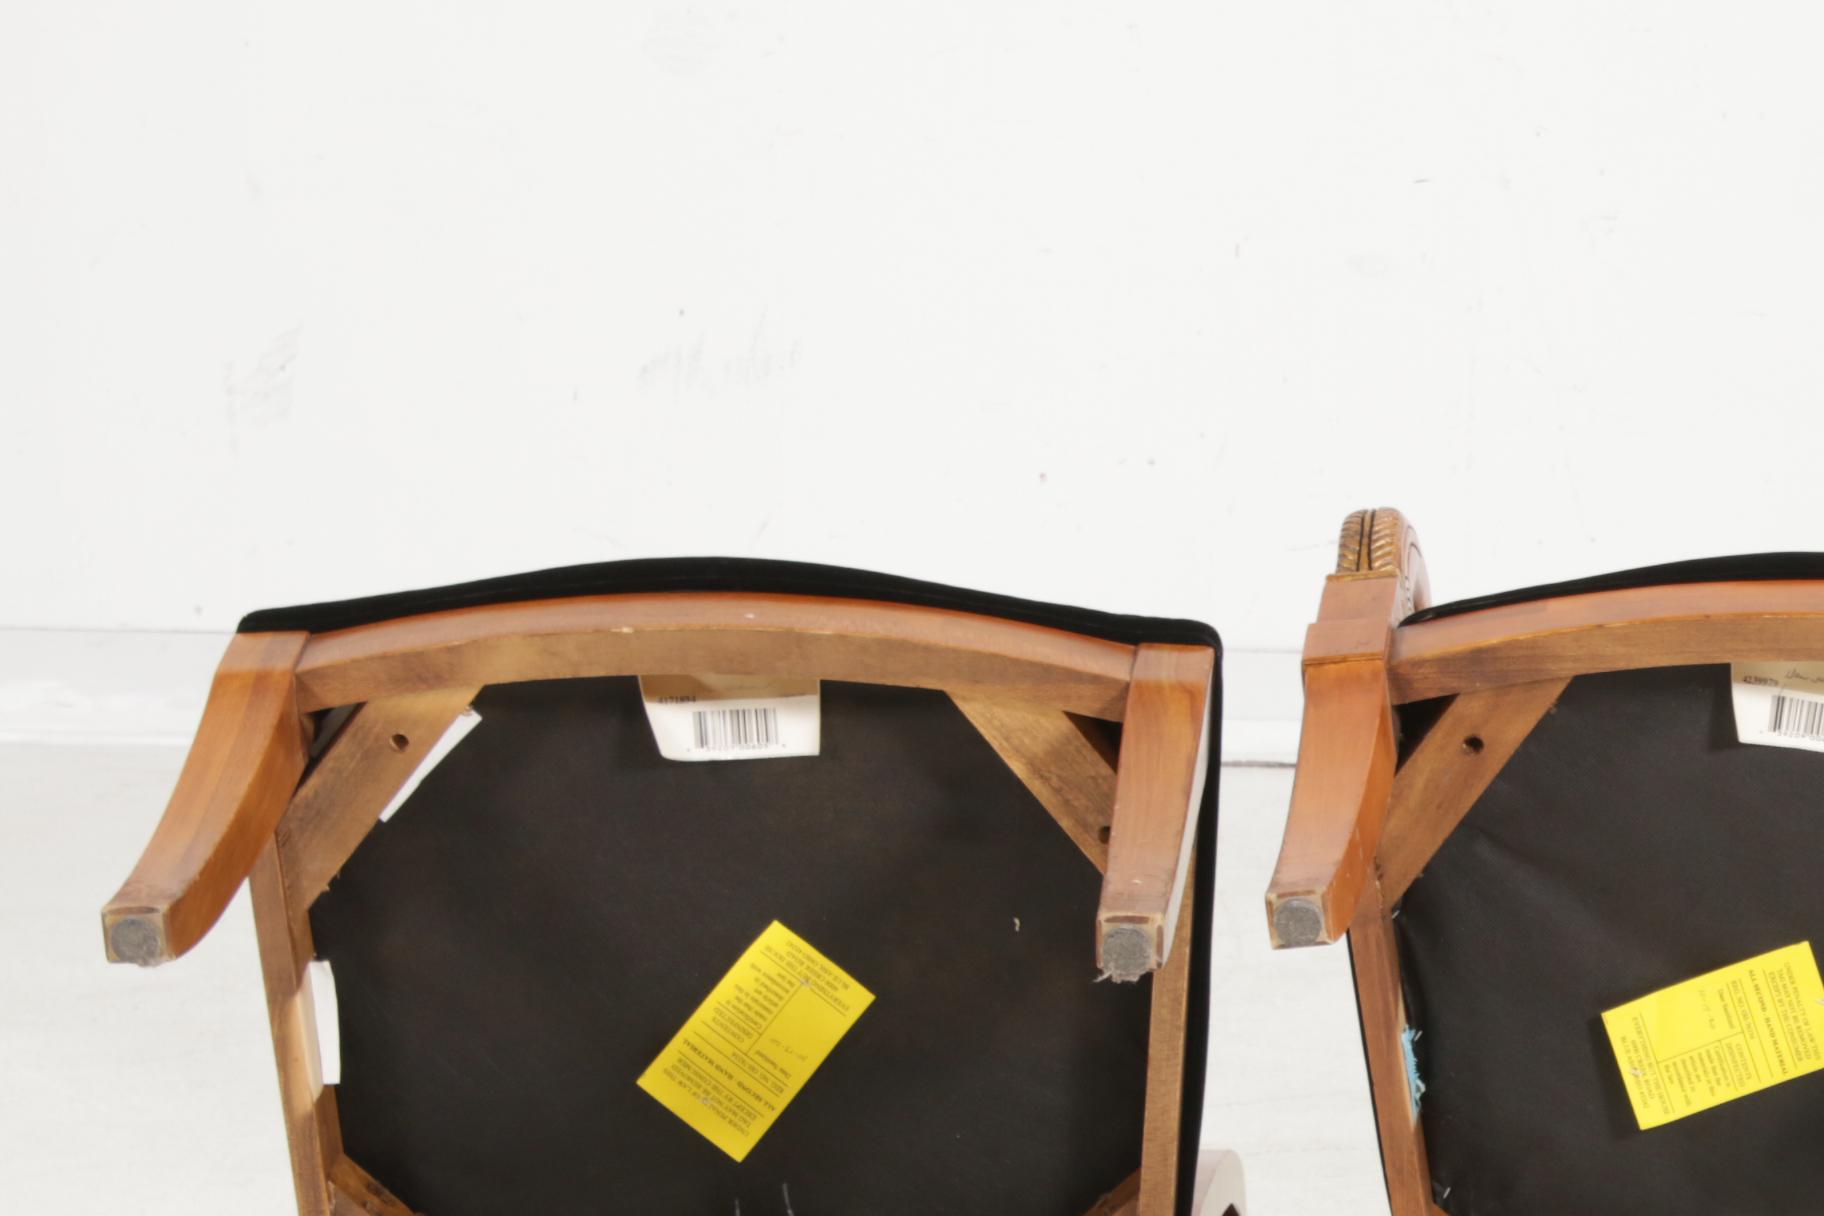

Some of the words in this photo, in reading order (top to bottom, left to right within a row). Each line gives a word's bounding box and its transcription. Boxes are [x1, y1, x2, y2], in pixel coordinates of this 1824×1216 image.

[1746, 968, 1757, 982] ALL
[1751, 982, 1768, 1013] SECOND
[1763, 1016, 1776, 1039] HAND
[680, 1037, 716, 1066] MATERIAL
[1770, 1037, 1789, 1076] MATERIAL
[713, 1062, 735, 1081] HAND
[735, 1079, 764, 1103] SECOND
[761, 1099, 776, 1113] ALL
